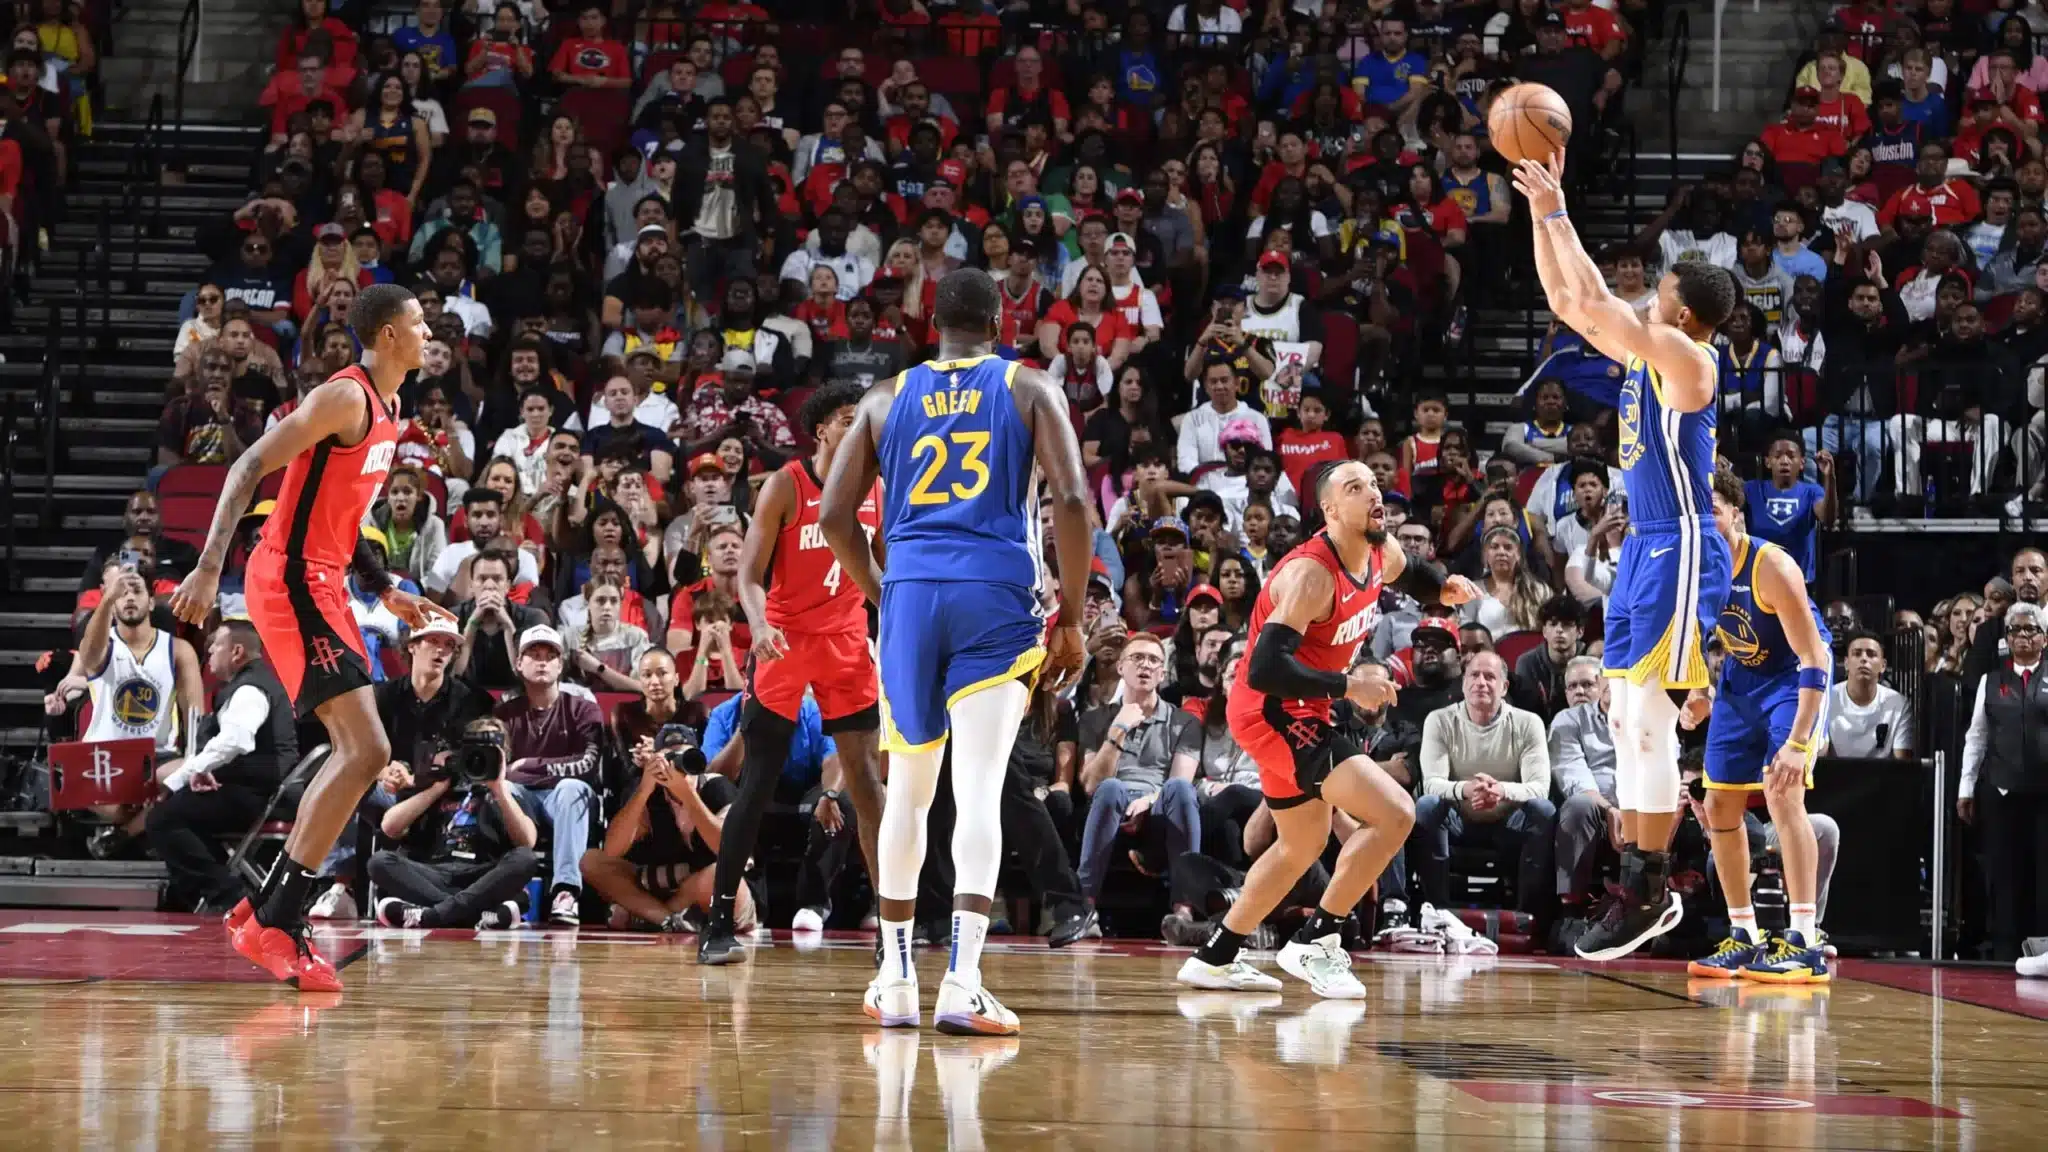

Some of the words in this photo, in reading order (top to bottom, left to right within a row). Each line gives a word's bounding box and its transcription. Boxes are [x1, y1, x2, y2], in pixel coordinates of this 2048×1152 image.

[921, 388, 983, 418] GREEN
[1624, 403, 1638, 423] 30
[909, 430, 990, 505] 23
[823, 559, 841, 597] 4
[1738, 623, 1748, 639] 11
[136, 686, 154, 702] 30
